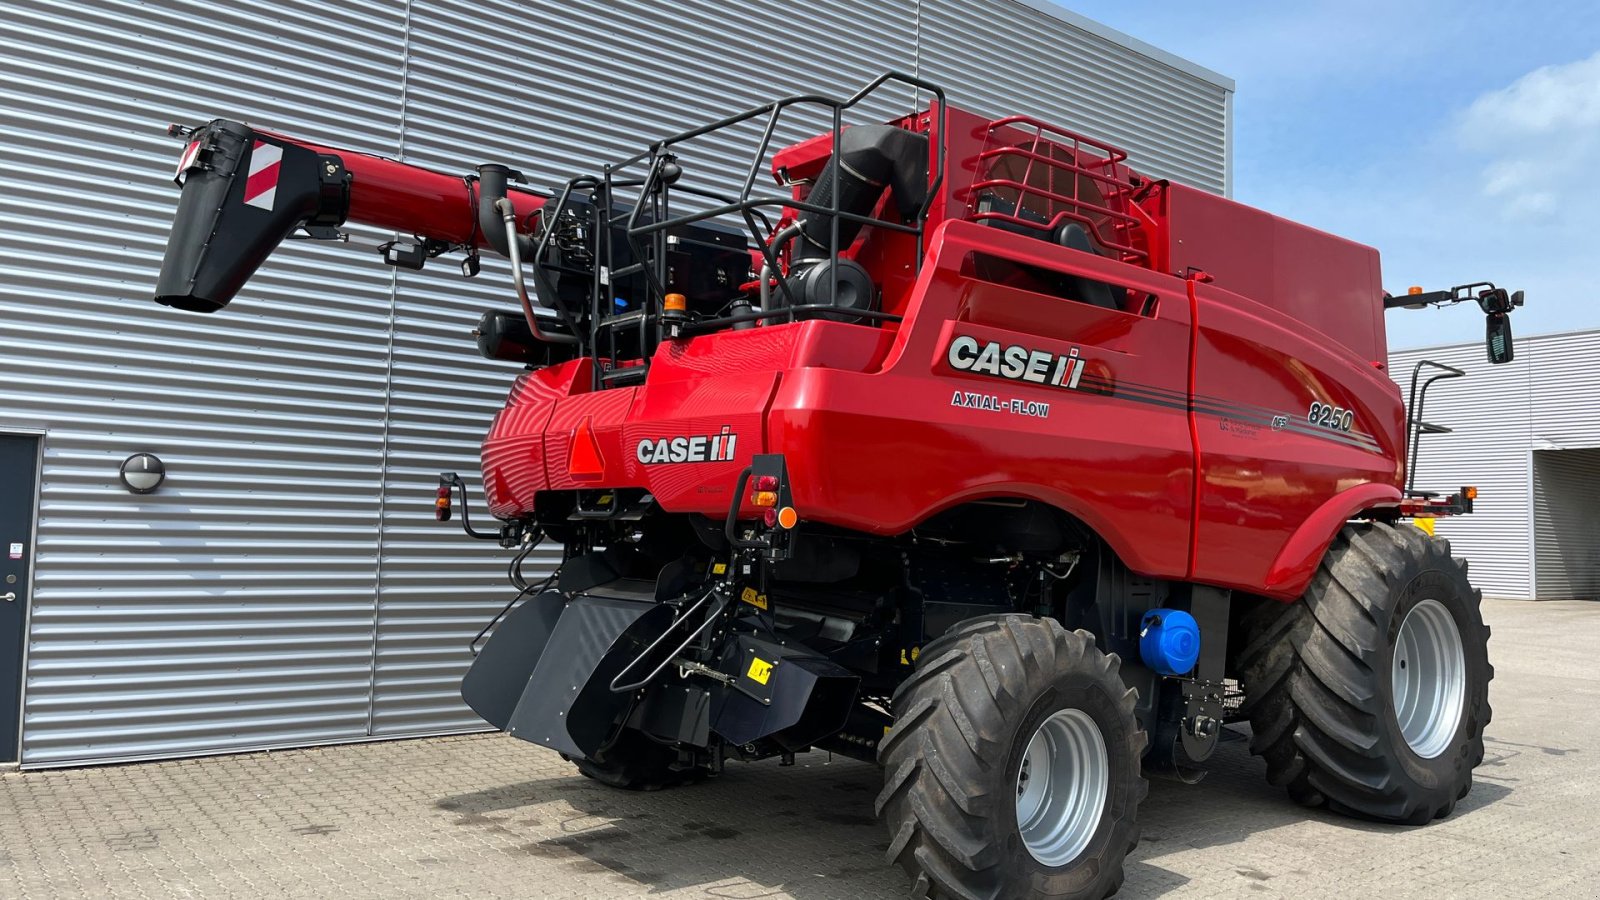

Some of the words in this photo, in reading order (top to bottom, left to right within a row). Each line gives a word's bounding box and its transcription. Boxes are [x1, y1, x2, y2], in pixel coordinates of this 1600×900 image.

[948, 335, 1053, 383] CASE
[951, 391, 1050, 418] AXIAL-FLOW
[1308, 401, 1354, 432] 8250
[637, 436, 708, 464] CASE
